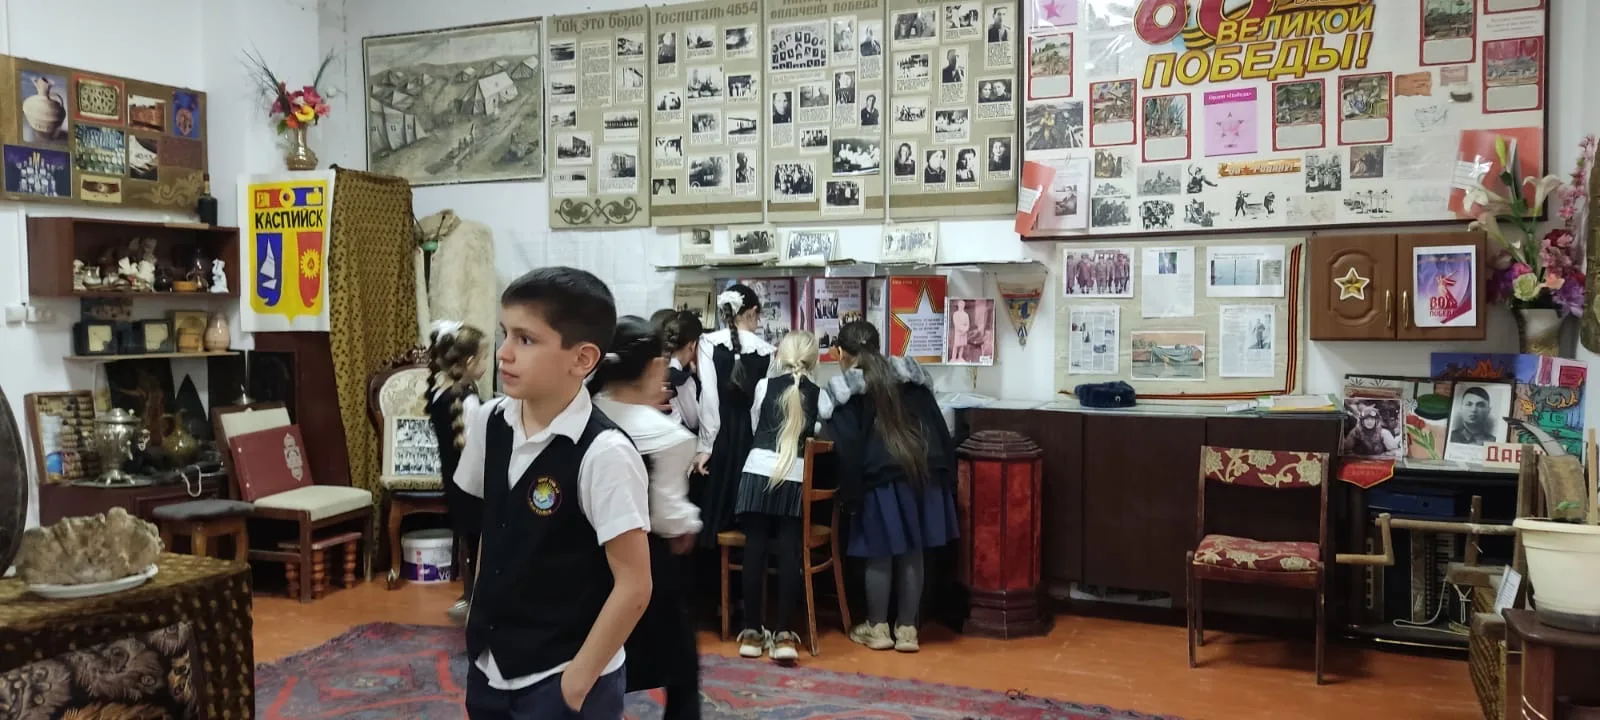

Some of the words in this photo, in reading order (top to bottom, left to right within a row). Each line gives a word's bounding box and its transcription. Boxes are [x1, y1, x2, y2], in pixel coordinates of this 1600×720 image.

[554, 18, 581, 34] Так
[581, 18, 604, 32] это
[608, 12, 644, 31] было
[655, 9, 724, 26] Госпиталь
[1215, 4, 1376, 45] ВЕЛИКОЙ
[1142, 32, 1374, 89] ПОБЕДЫ!
[254, 208, 323, 229] КАСПИЙСК
